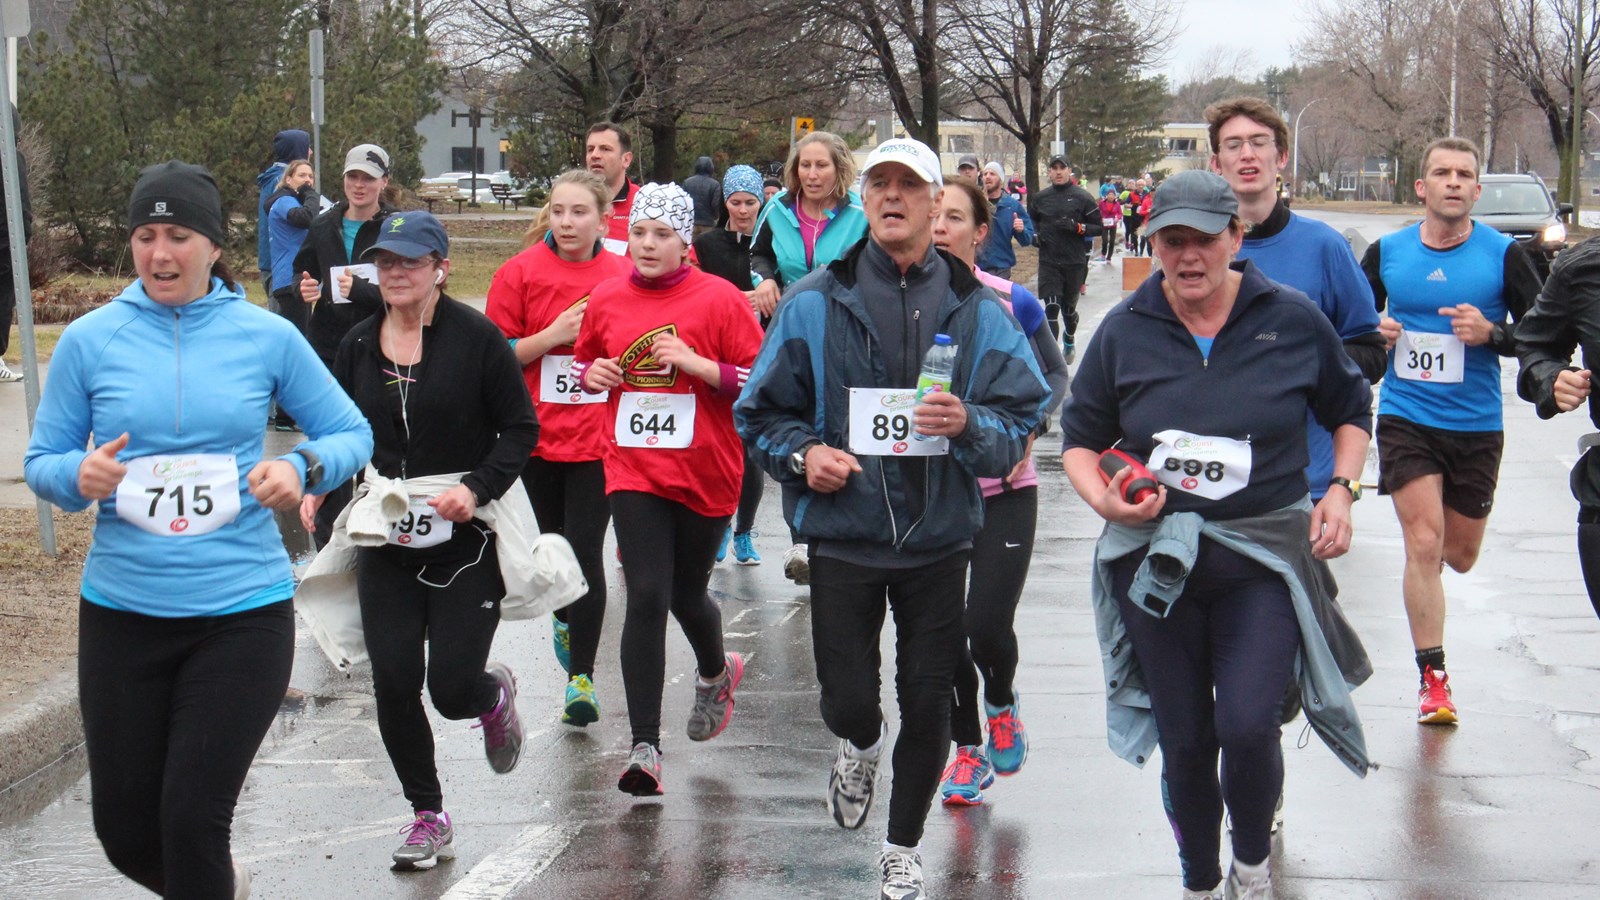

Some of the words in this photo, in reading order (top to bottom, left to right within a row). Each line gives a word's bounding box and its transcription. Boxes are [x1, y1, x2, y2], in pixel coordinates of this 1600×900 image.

[1407, 350, 1444, 371] 301
[556, 375, 582, 394] 52
[630, 413, 676, 435] 644
[872, 414, 910, 441] 89
[145, 485, 214, 518] 715
[392, 510, 433, 537] 95
